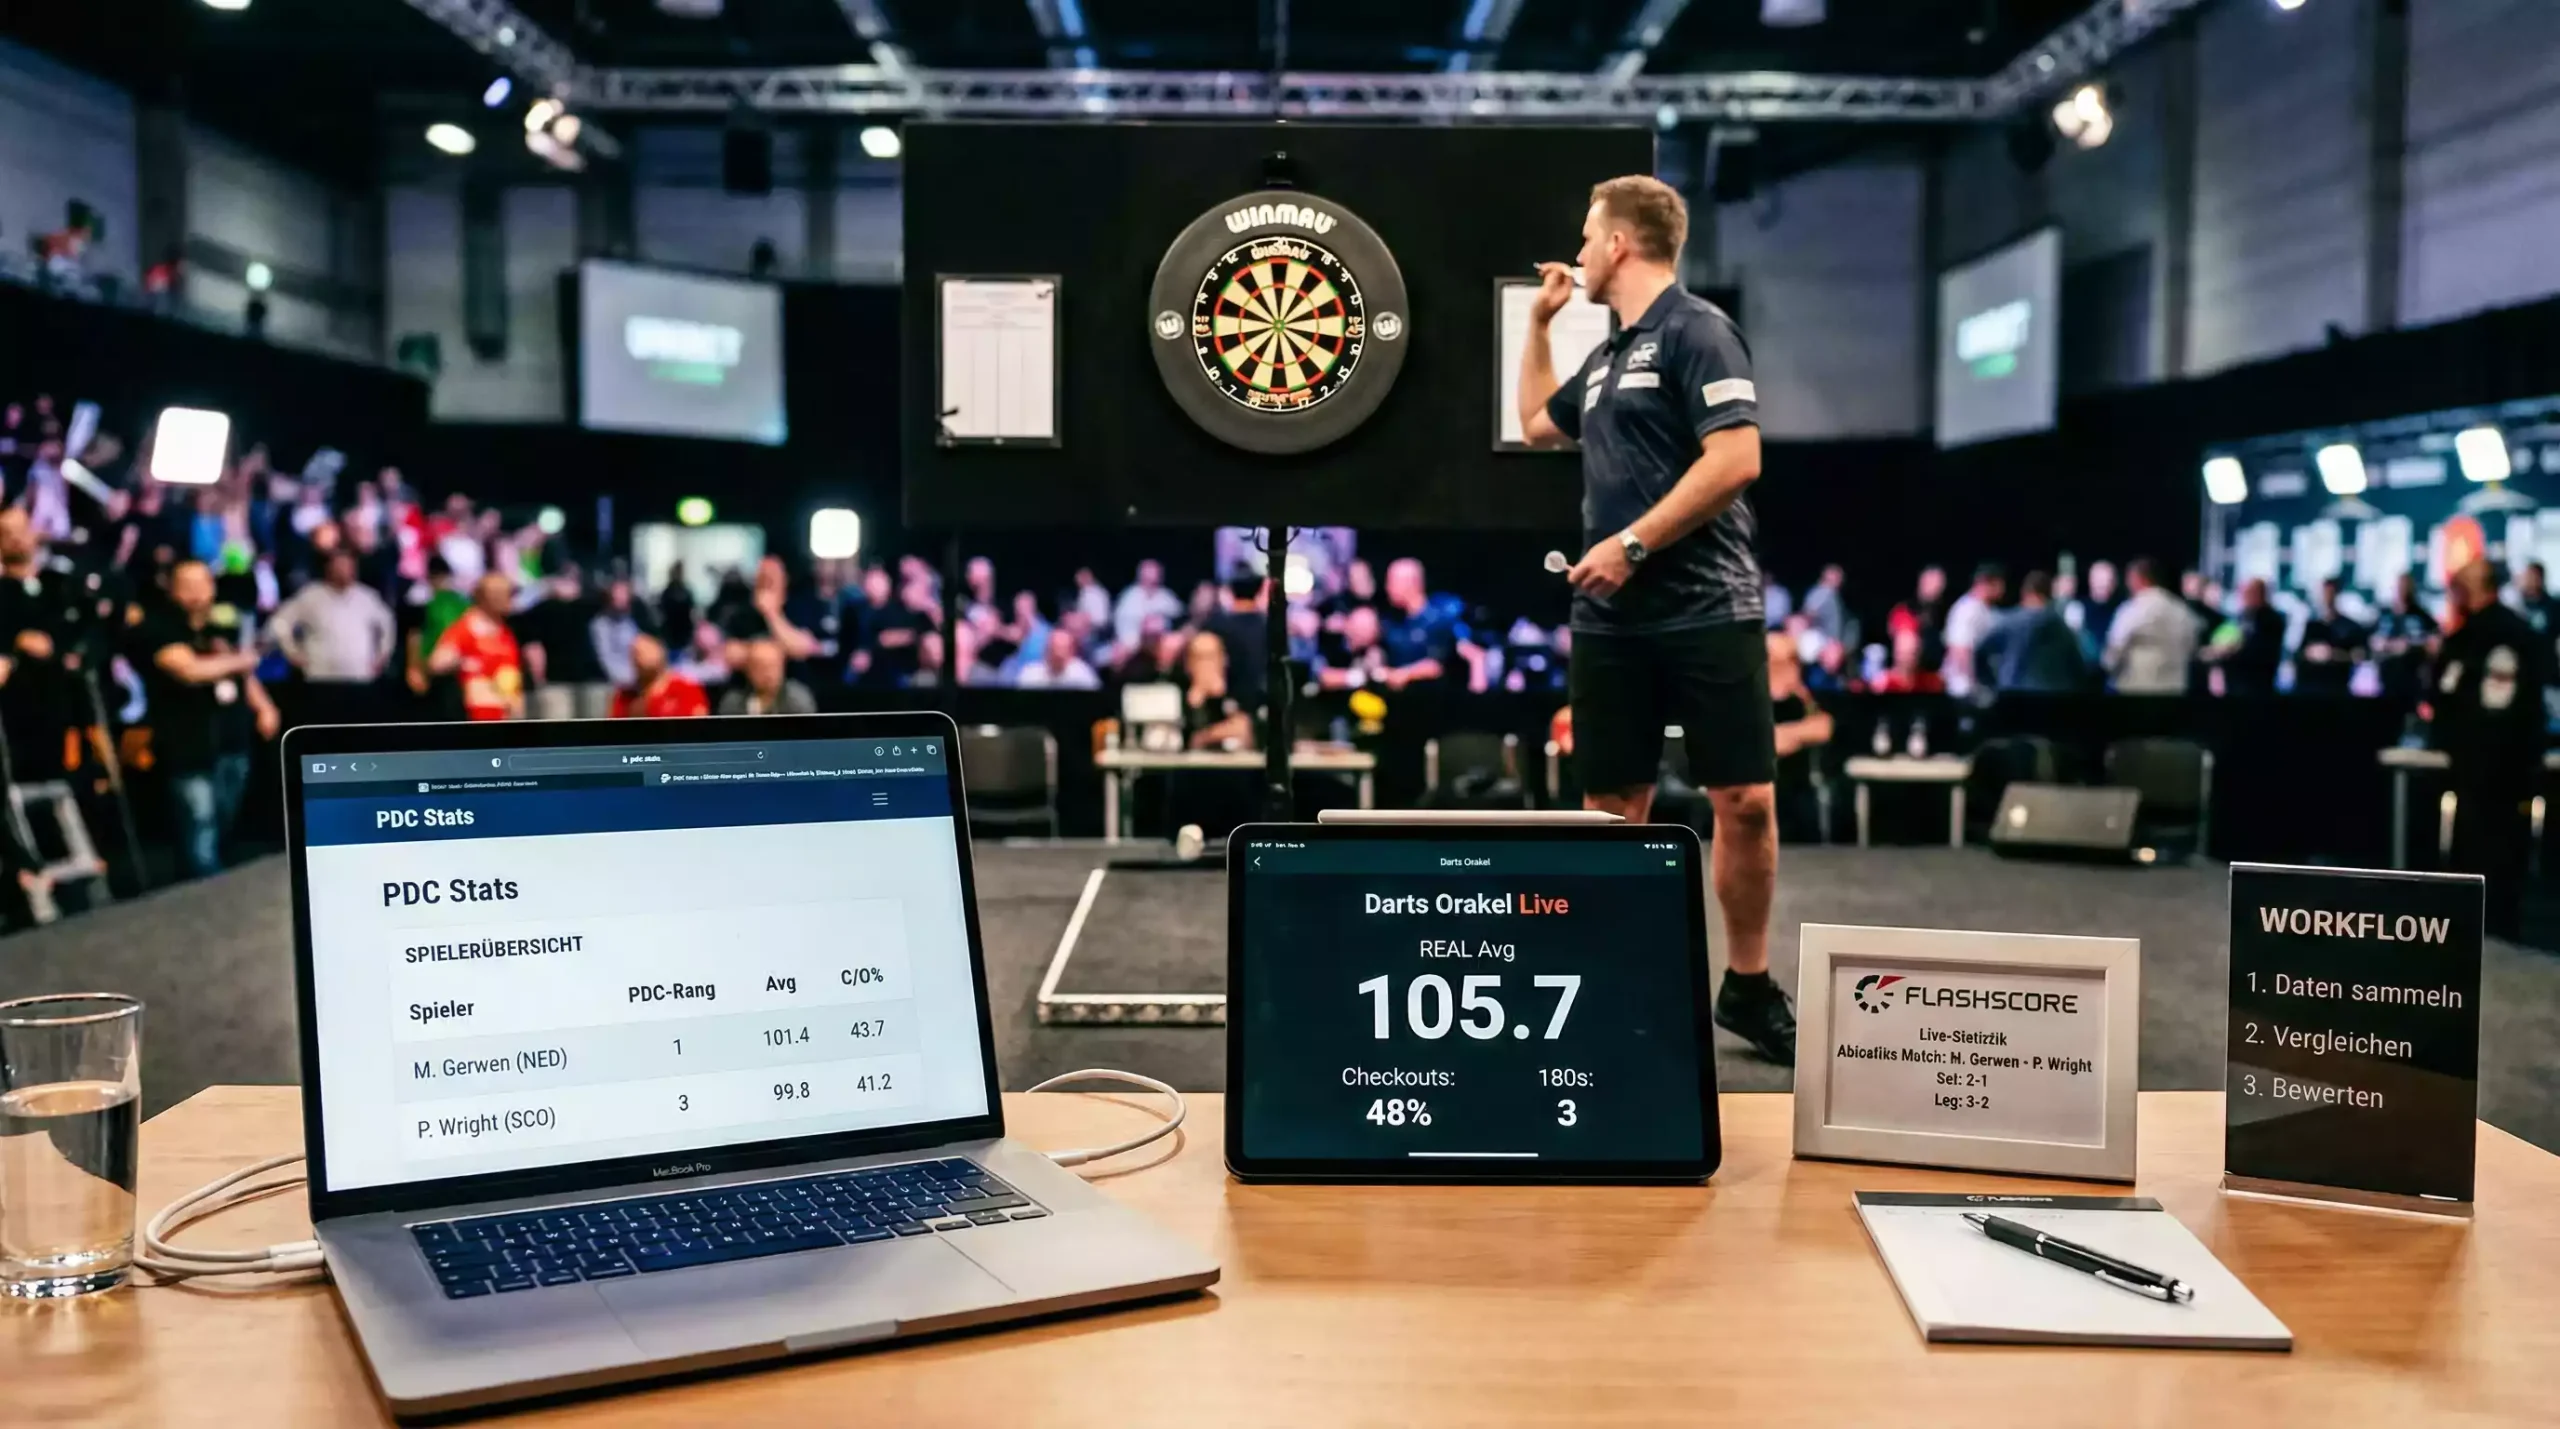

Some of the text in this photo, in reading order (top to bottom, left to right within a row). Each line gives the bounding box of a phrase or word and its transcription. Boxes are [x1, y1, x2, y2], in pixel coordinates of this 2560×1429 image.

[376, 808, 474, 828] PDC Stats
[1440, 857, 1490, 866] Darts Orakel
[383, 878, 518, 906] PDC Stats
[1365, 892, 1568, 914] Darts Orakel Live
[2259, 906, 2450, 943] WORKFLOW
[405, 935, 582, 963] SPIELERÜBERSICHT
[1420, 939, 1514, 962] REAL Avg
[409, 999, 474, 1024] Spieler
[628, 982, 715, 1003] PDC-Rang
[765, 975, 796, 993] Avg
[1904, 985, 2078, 1014] FLASHSCORE
[2247, 971, 2461, 1008] 1. Daten sammeln
[1358, 973, 1581, 1039] 105.7
[414, 1019, 884, 1079] M. Gerwen (NED) 1 101.4 43.7
[2245, 1022, 2411, 1057] 2. Vergleichen
[1342, 1066, 1593, 1086] Checkouts: 180s:
[1969, 1052, 2019, 1068] Gerwen
[2032, 1055, 2043, 1069] P.
[2047, 1056, 2092, 1075] Wright
[1966, 1073, 1986, 1087] 2-1
[2243, 1074, 2382, 1108] 3. Bewerten
[417, 1073, 892, 1138] P. Wright (SCO) 3 99.8 41.2
[1365, 1098, 1577, 1126] 48% 3
[1934, 1092, 1989, 1110] Leg: 3-2
